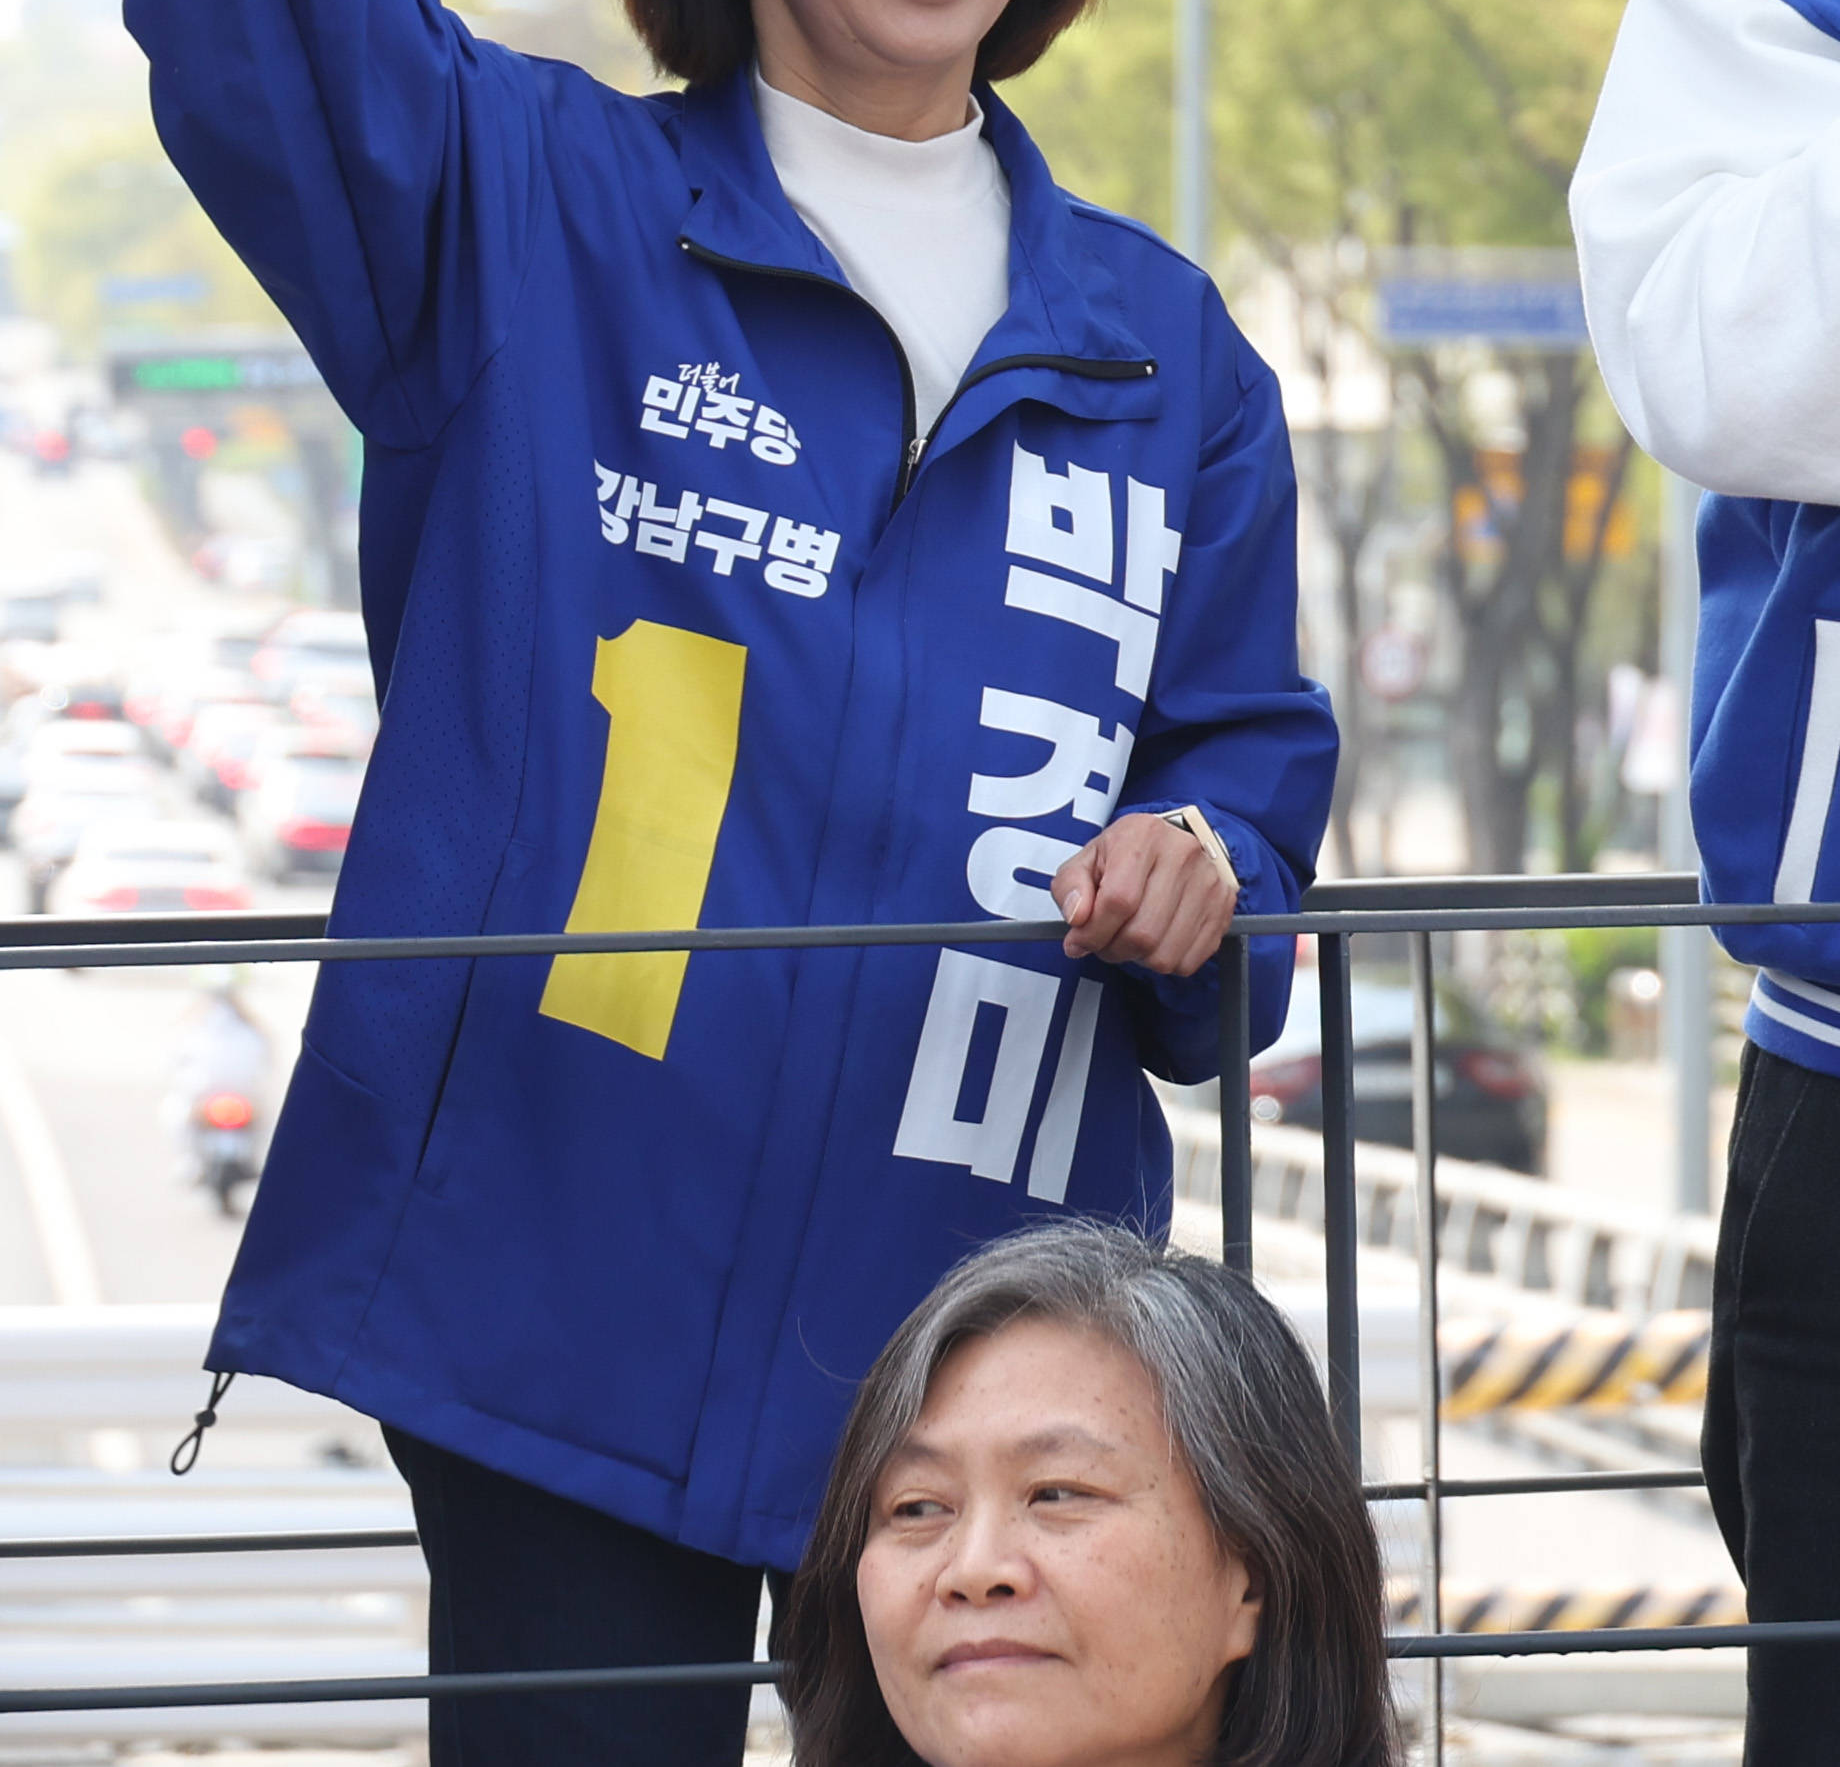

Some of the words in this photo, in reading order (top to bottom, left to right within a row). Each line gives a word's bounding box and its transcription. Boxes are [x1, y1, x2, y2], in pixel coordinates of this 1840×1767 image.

[639, 374, 802, 467] 민주당
[677, 361, 741, 395] 더불어
[593, 457, 842, 599] 강남구병
[538, 617, 749, 1063] 1
[891, 438, 1183, 1205] 박경미
